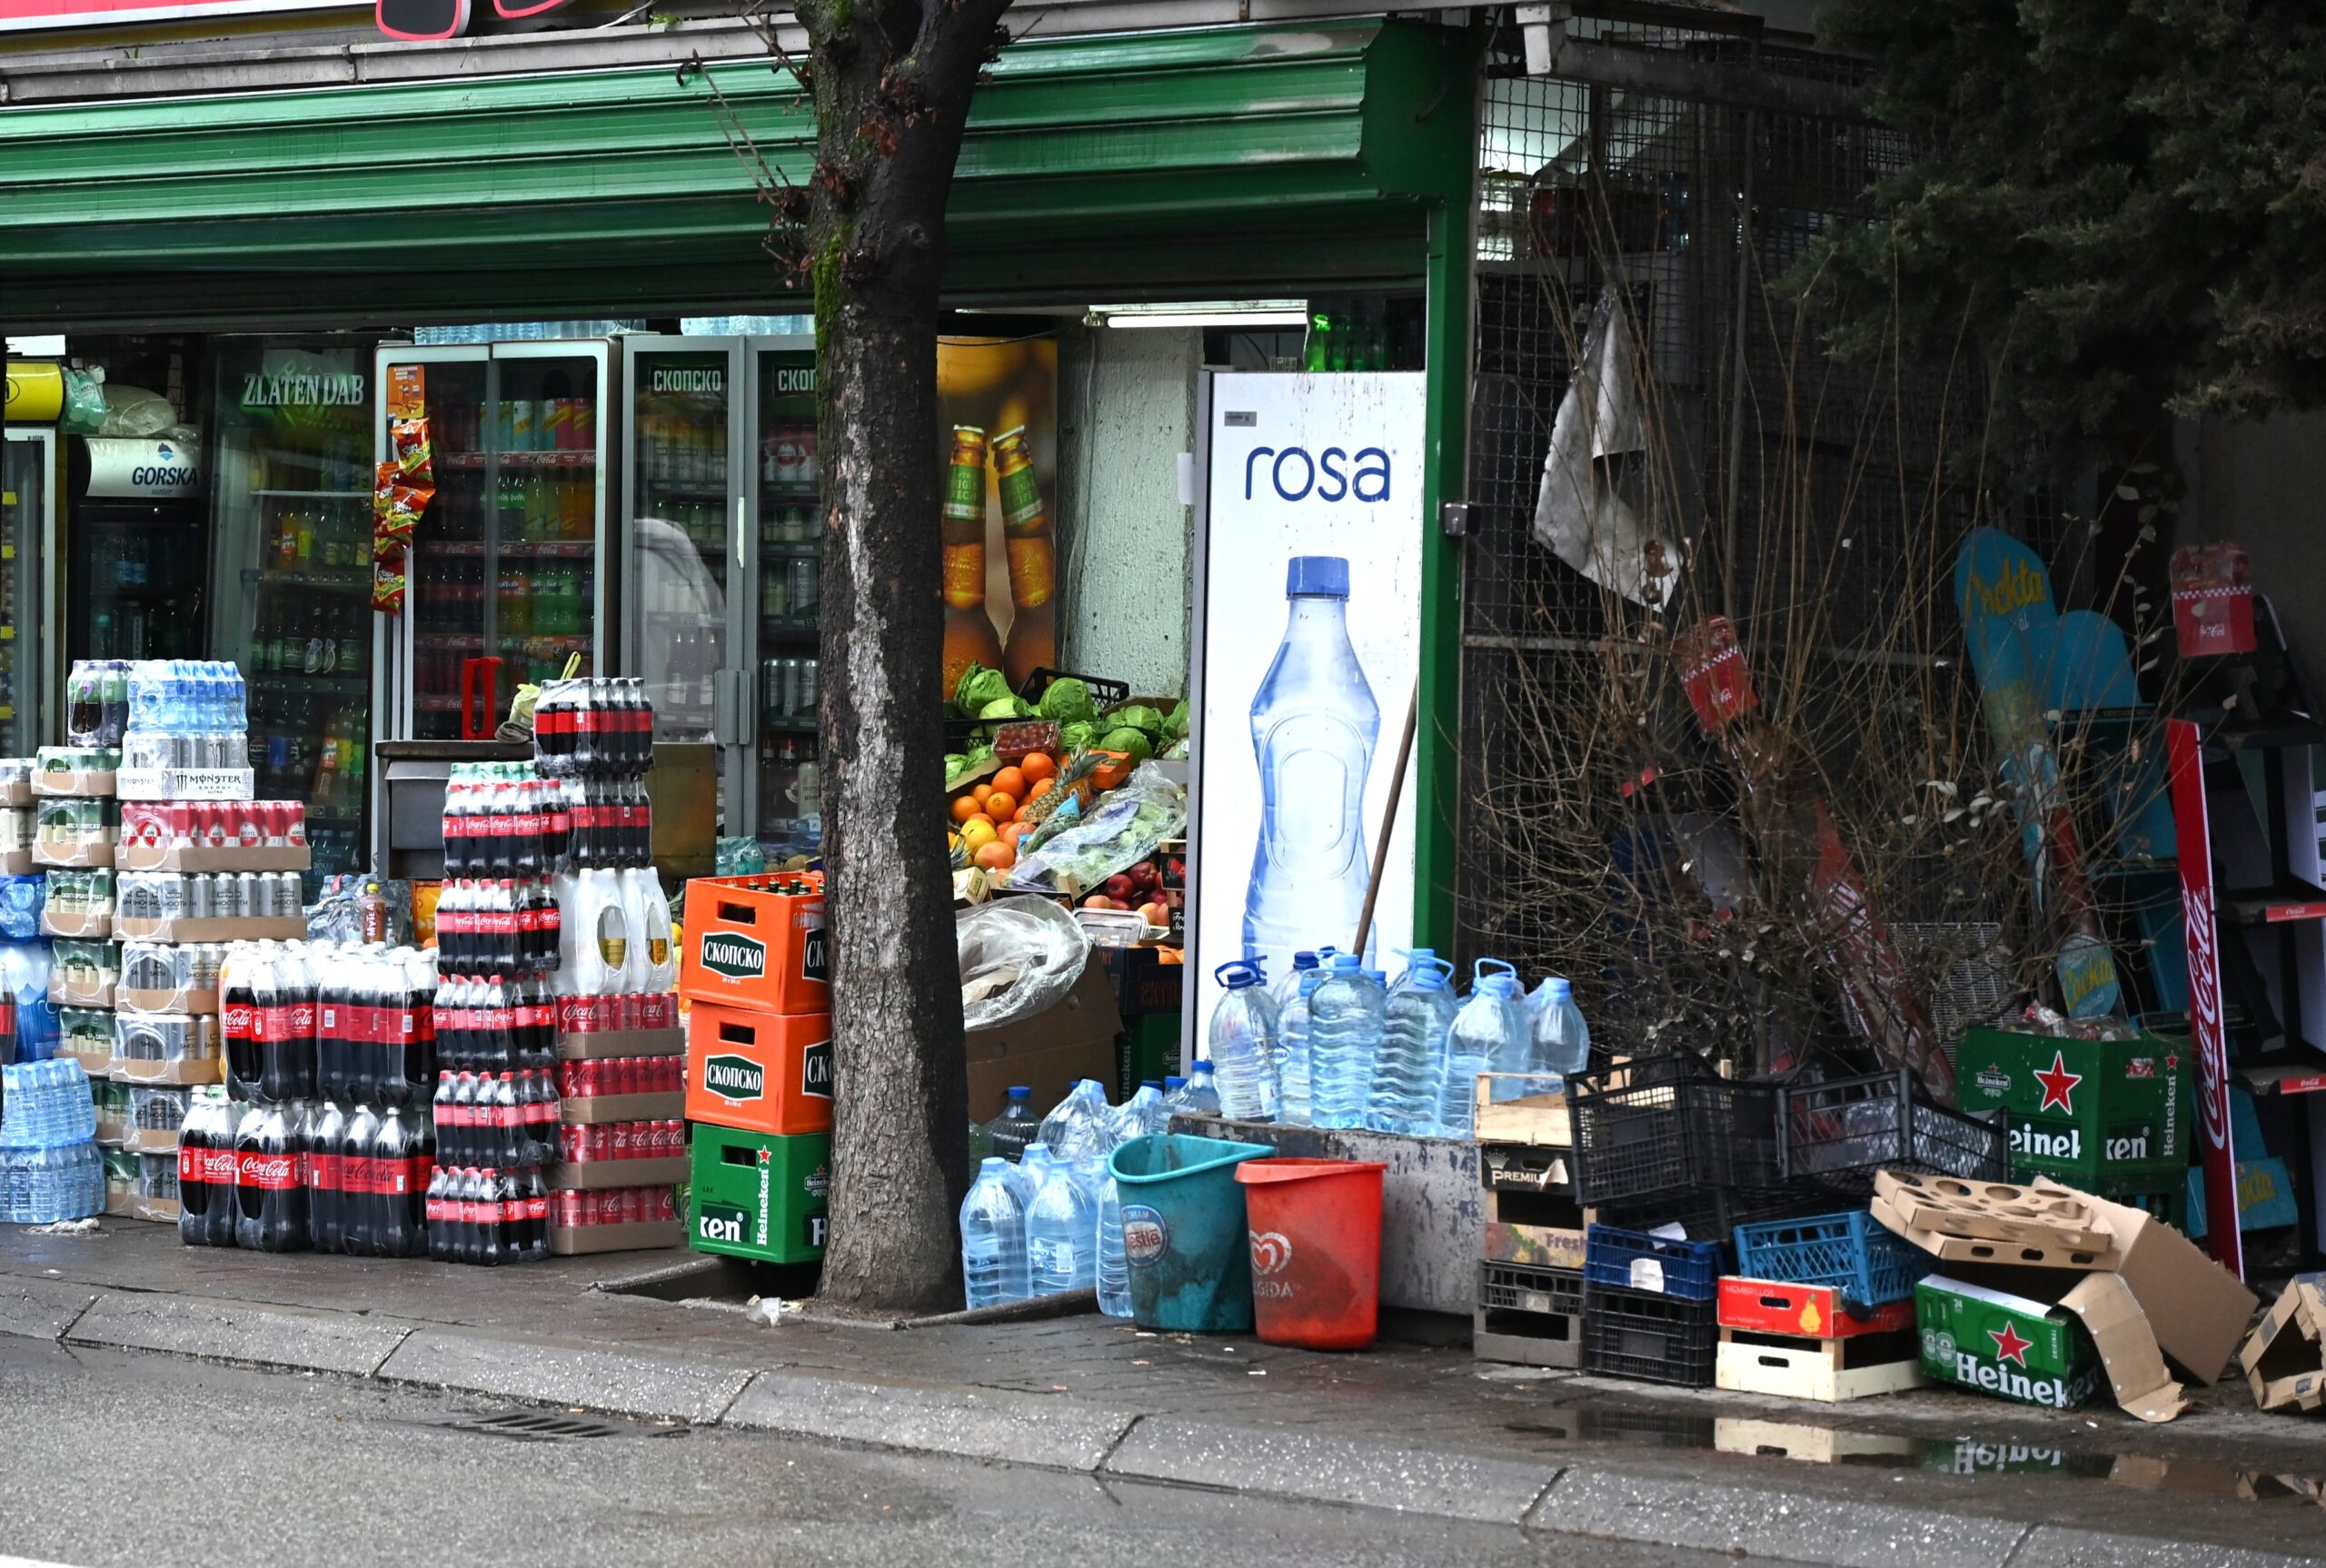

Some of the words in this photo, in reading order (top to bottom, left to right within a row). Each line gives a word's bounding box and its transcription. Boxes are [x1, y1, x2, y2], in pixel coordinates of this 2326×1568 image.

[243, 373, 319, 407] ZLATEN
[322, 373, 364, 406] DAB
[132, 467, 198, 485] GORSKA
[1245, 446, 1391, 502] rosa
[703, 940, 763, 969] СКОПСКО
[2181, 871, 2226, 1150] Coca-Cola
[707, 1063, 762, 1091] СКОПСКО
[1976, 1076, 2009, 1087] Heineken
[2163, 1075, 2177, 1156] Heineken
[1492, 1169, 1543, 1186] PREMIU
[757, 1167, 770, 1246] Heineken
[1953, 1298, 1963, 1309] 24
